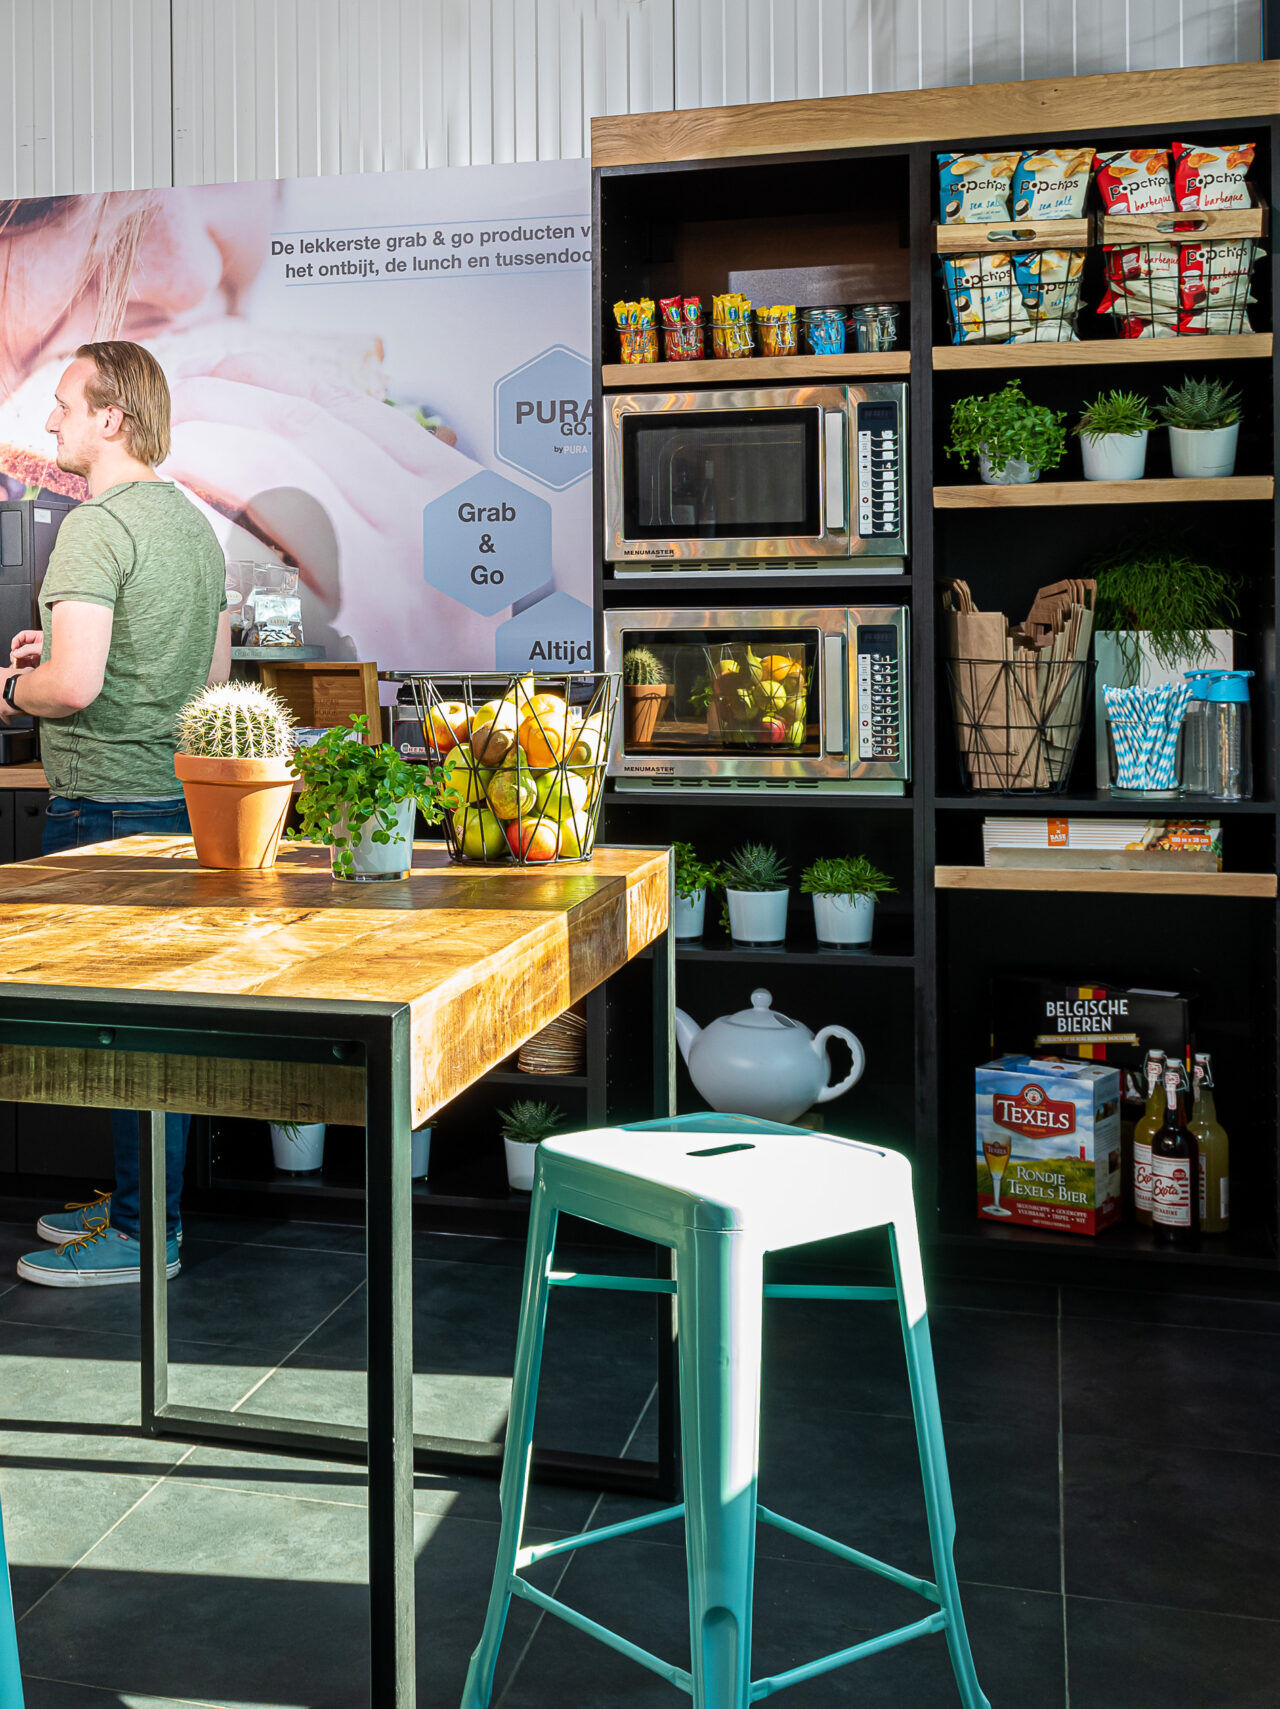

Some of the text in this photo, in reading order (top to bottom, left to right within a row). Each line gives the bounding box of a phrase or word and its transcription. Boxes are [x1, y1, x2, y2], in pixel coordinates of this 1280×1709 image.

[950, 179, 1006, 196] popchips
[1020, 178, 1079, 194] popchips
[1039, 195, 1074, 210] sea salt
[1205, 192, 1244, 207] barbeque
[271, 240, 294, 257] De
[300, 237, 381, 255] lekkerste
[386, 232, 427, 252] grab
[432, 231, 446, 246] &
[451, 233, 474, 249] go
[480, 224, 575, 247] producten
[285, 248, 592, 278] het ontbijt, de lunch en tussendoo
[560, 422, 591, 437] GO.
[554, 445, 588, 454] by PURA
[458, 502, 517, 522] Grab
[478, 533, 496, 554] &
[470, 564, 505, 586] Go
[528, 640, 592, 664] Altijd
[1046, 999, 1128, 1017] BELGISCHE
[1057, 1016, 1112, 1033] BIEREN
[997, 1099, 1070, 1129] TEXELS
[1017, 1166, 1066, 1186] RONDJE
[1136, 1167, 1152, 1184] Exo
[1006, 1179, 1088, 1204] TEXELS BIER
[1154, 1179, 1180, 1197] Exota
